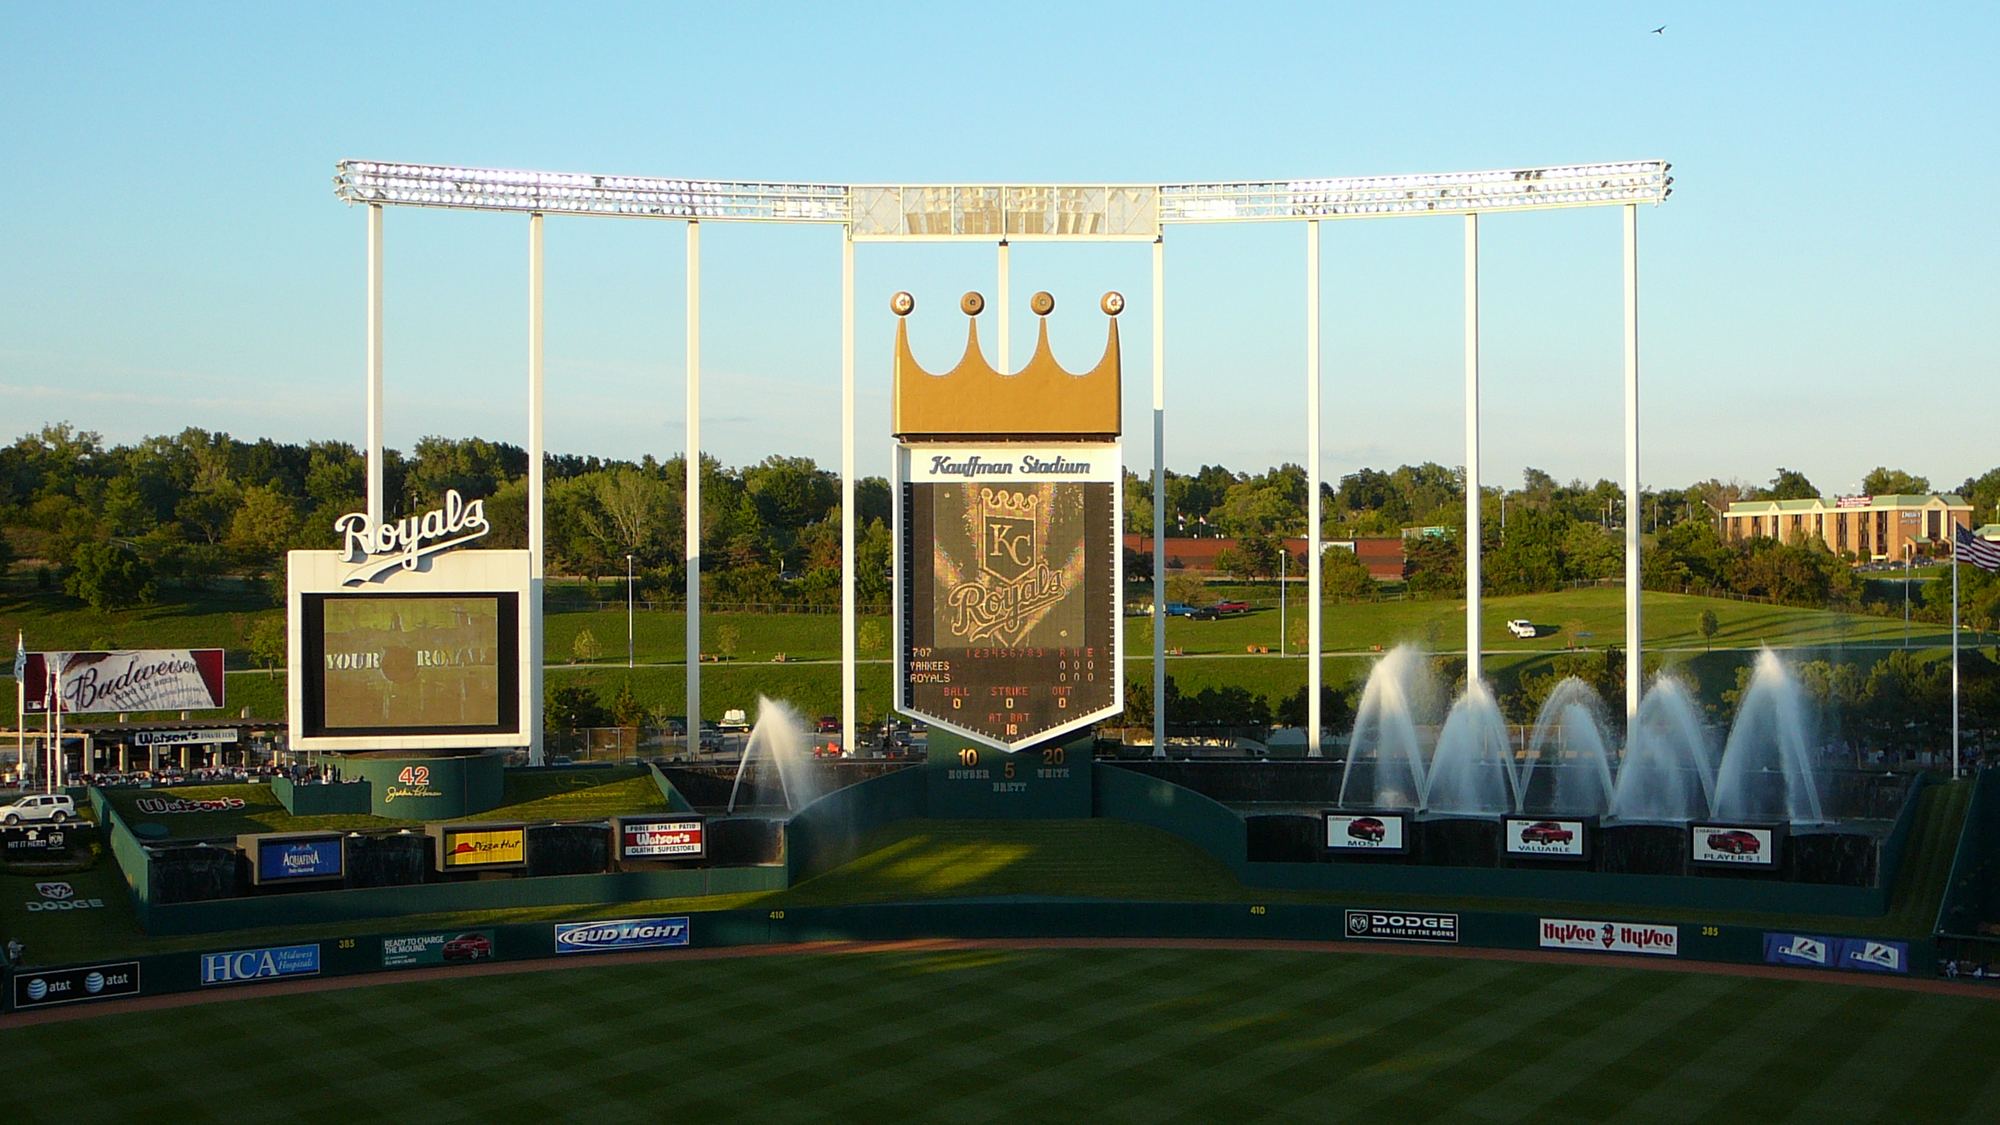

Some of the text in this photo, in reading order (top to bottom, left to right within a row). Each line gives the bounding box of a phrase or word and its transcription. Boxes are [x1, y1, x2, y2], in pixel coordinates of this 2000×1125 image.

[929, 455, 1091, 477] Kauffman Stadium
[334, 489, 490, 572] Royals
[989, 523, 1031, 566] KC
[948, 563, 1067, 637] Royals
[326, 652, 380, 669] YOUR
[910, 660, 950, 671] YANKEES
[64, 653, 197, 709] Budweiser
[909, 673, 951, 683] ROYALS
[943, 686, 1072, 697] BALL STRIKE OUT
[953, 697, 1067, 709] 0 0 0
[988, 713, 1030, 723] AT BAT
[138, 731, 198, 744] Watson's
[957, 747, 1065, 766] 10 20
[398, 766, 429, 786] 42
[1004, 762, 1015, 778] 5
[136, 796, 246, 814] Watson's
[636, 831, 690, 846] Watson's
[473, 839, 521, 852] Pizza Hut
[657, 845, 695, 853] SUPERSTORE
[1518, 845, 1570, 853] VALUABLE
[282, 850, 320, 867] AQUAFINA
[25, 899, 104, 912] DODGE
[1250, 906, 1265, 915] 410
[769, 910, 784, 920] 410
[1372, 915, 1454, 929] DODGE
[572, 923, 685, 944] BUD LIGHT
[1702, 926, 1719, 937] 385
[338, 939, 355, 949] 385
[384, 935, 445, 948] READY TO CHARGE
[279, 950, 312, 961] Midwest
[385, 945, 398, 954] THE
[206, 951, 280, 982] HCA
[279, 959, 313, 971] Hospitals
[106, 973, 129, 985] at&t
[49, 980, 71, 992] at&t
